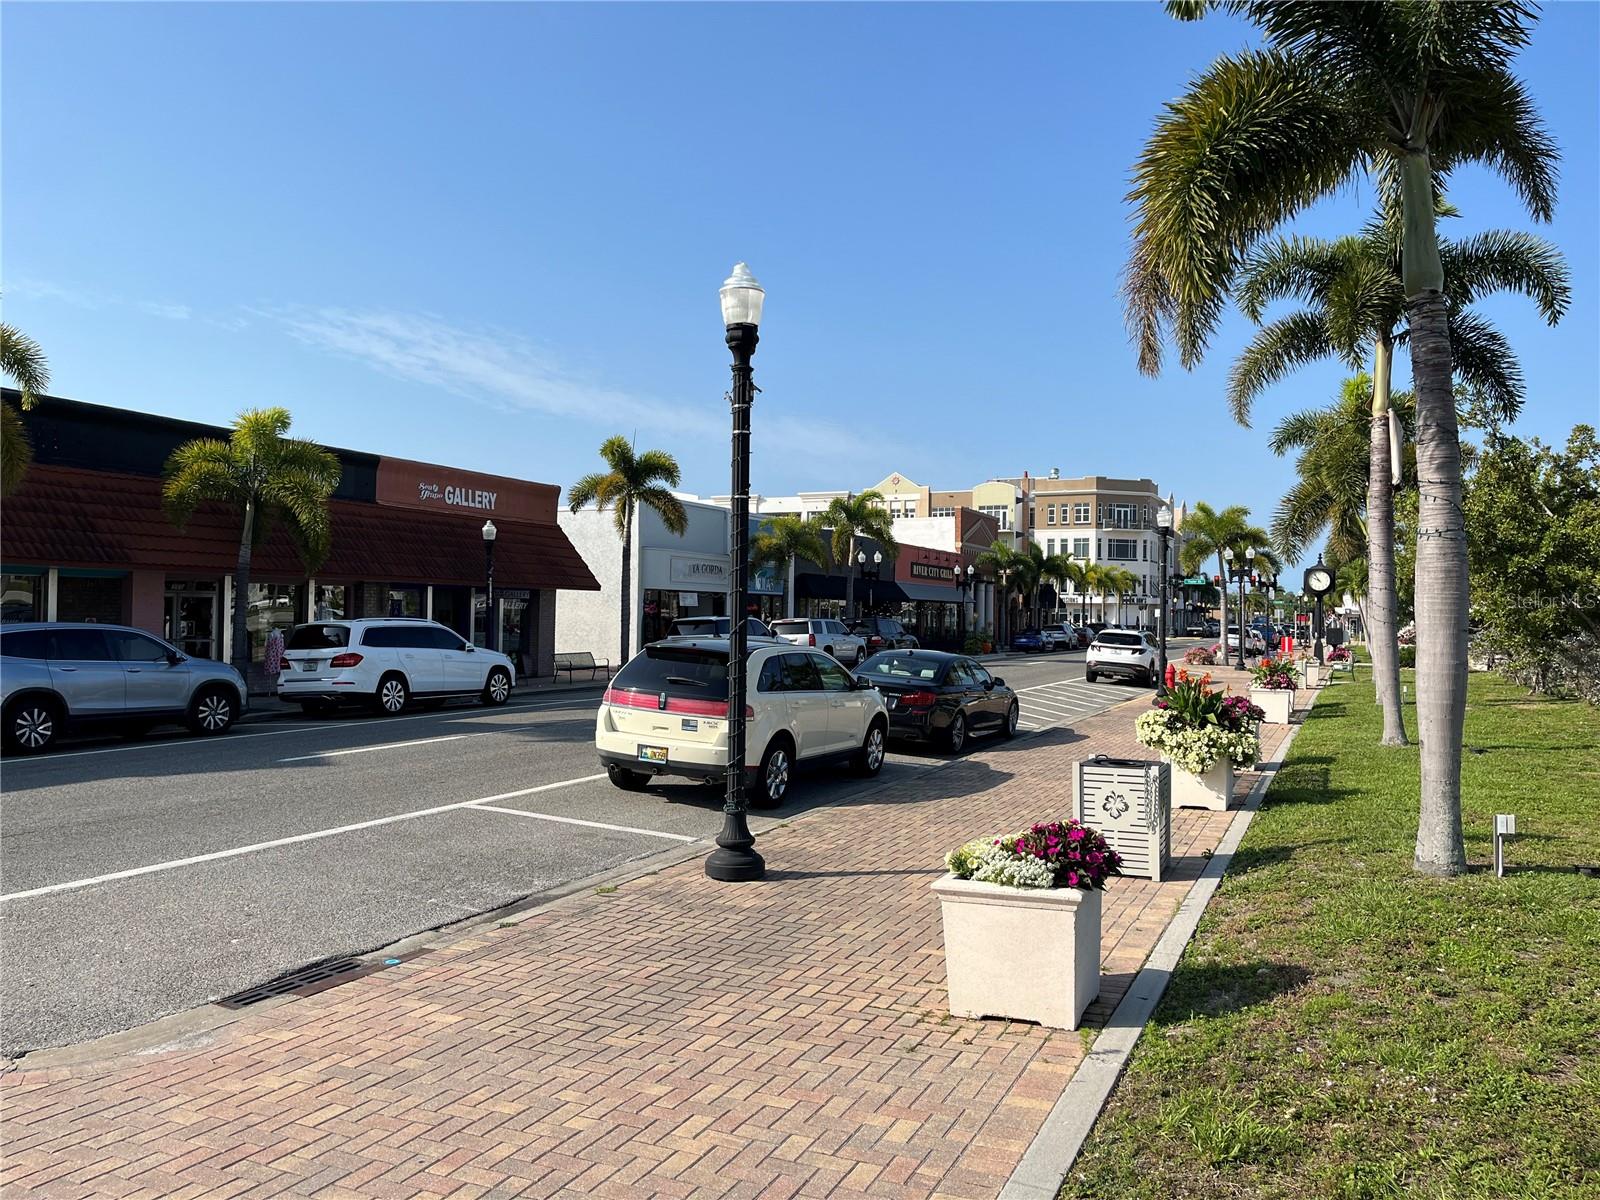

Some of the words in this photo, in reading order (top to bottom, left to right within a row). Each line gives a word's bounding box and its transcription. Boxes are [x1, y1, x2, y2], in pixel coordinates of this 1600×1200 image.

[444, 486, 497, 510] GALLERY
[912, 564, 928, 577] RIVER
[928, 566, 940, 578] CITY
[940, 567, 953, 579] GRILL
